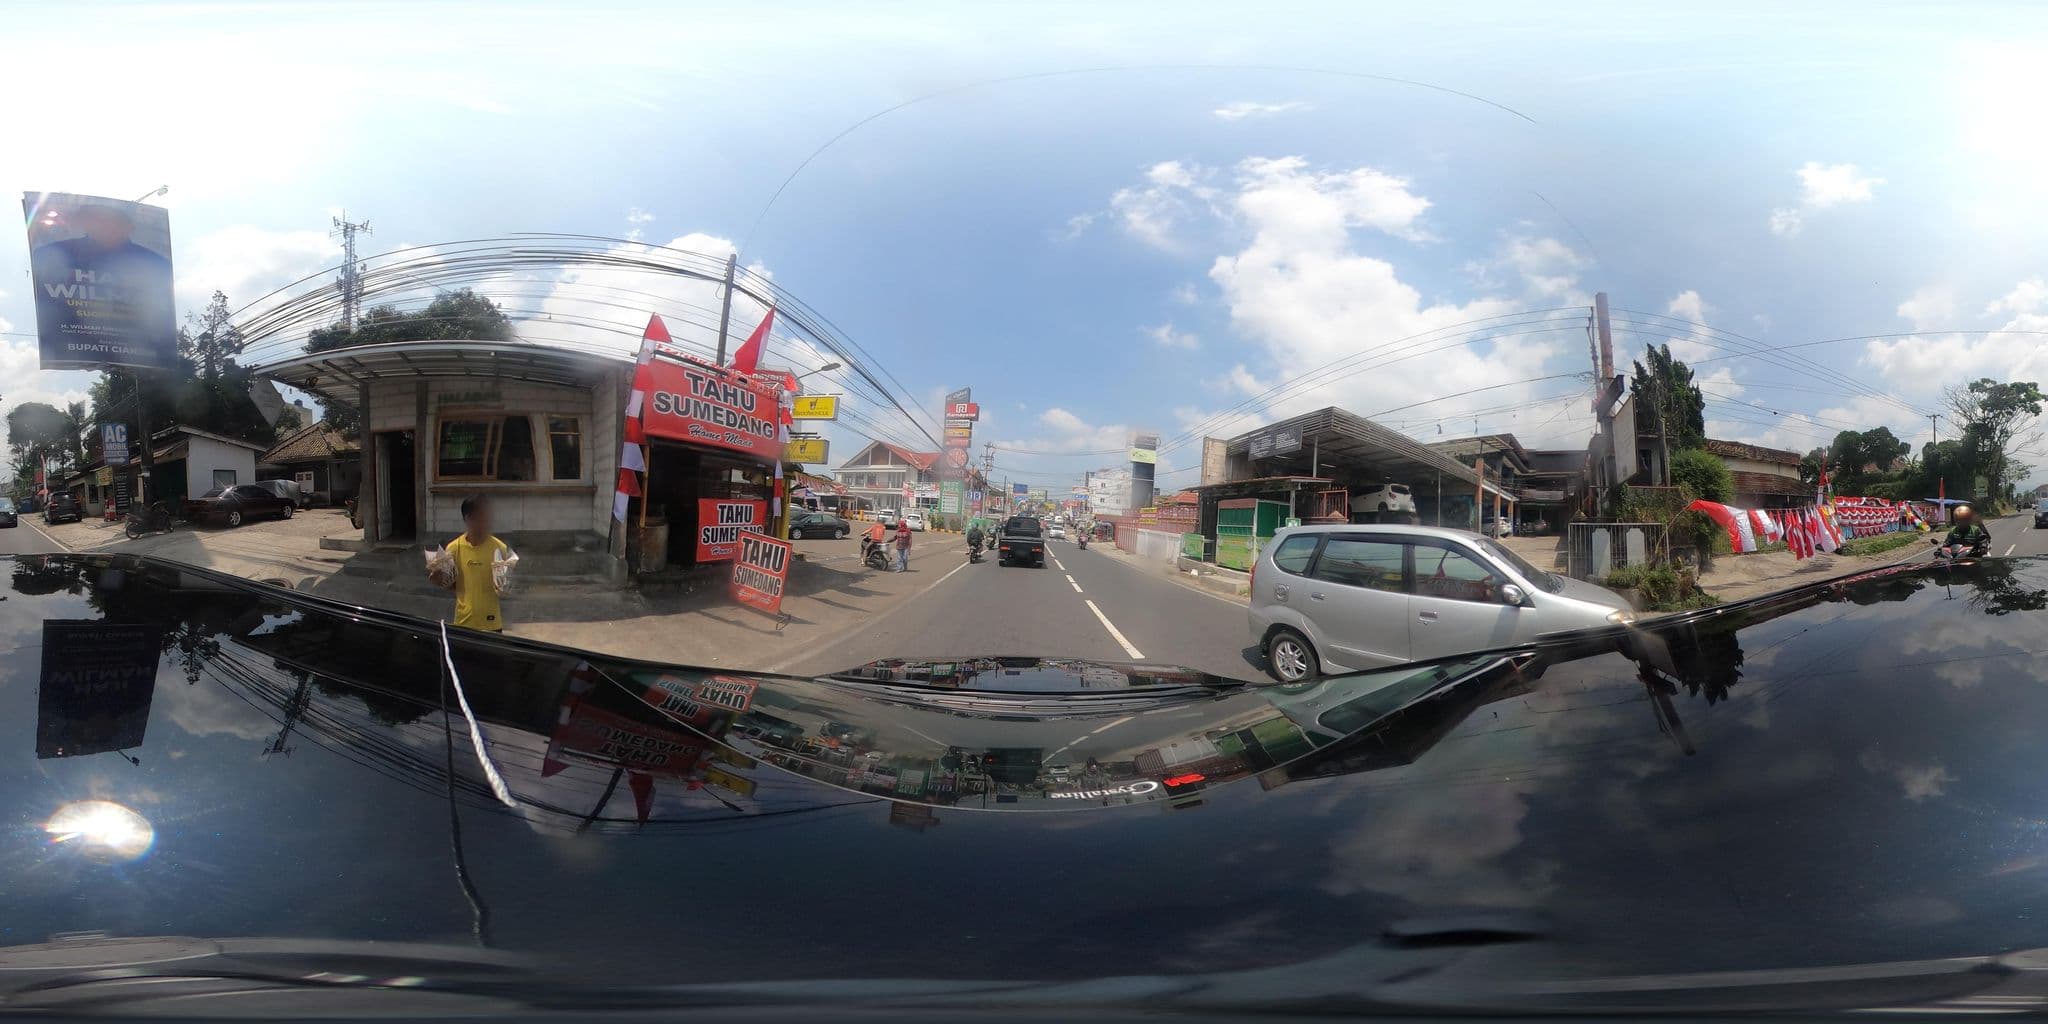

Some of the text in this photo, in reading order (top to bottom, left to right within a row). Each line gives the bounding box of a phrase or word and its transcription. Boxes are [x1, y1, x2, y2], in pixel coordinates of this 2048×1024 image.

[67, 343, 109, 353] BUPATI
[685, 371, 756, 413] TAHU
[654, 391, 774, 439] SUMEDANG
[105, 424, 127, 443] AC
[687, 423, 722, 440] Home
[718, 504, 754, 525] TAHU
[741, 536, 787, 573] TAHU
[734, 565, 782, 597] SUMEDANG
[1050, 780, 1159, 800] Crystalline
